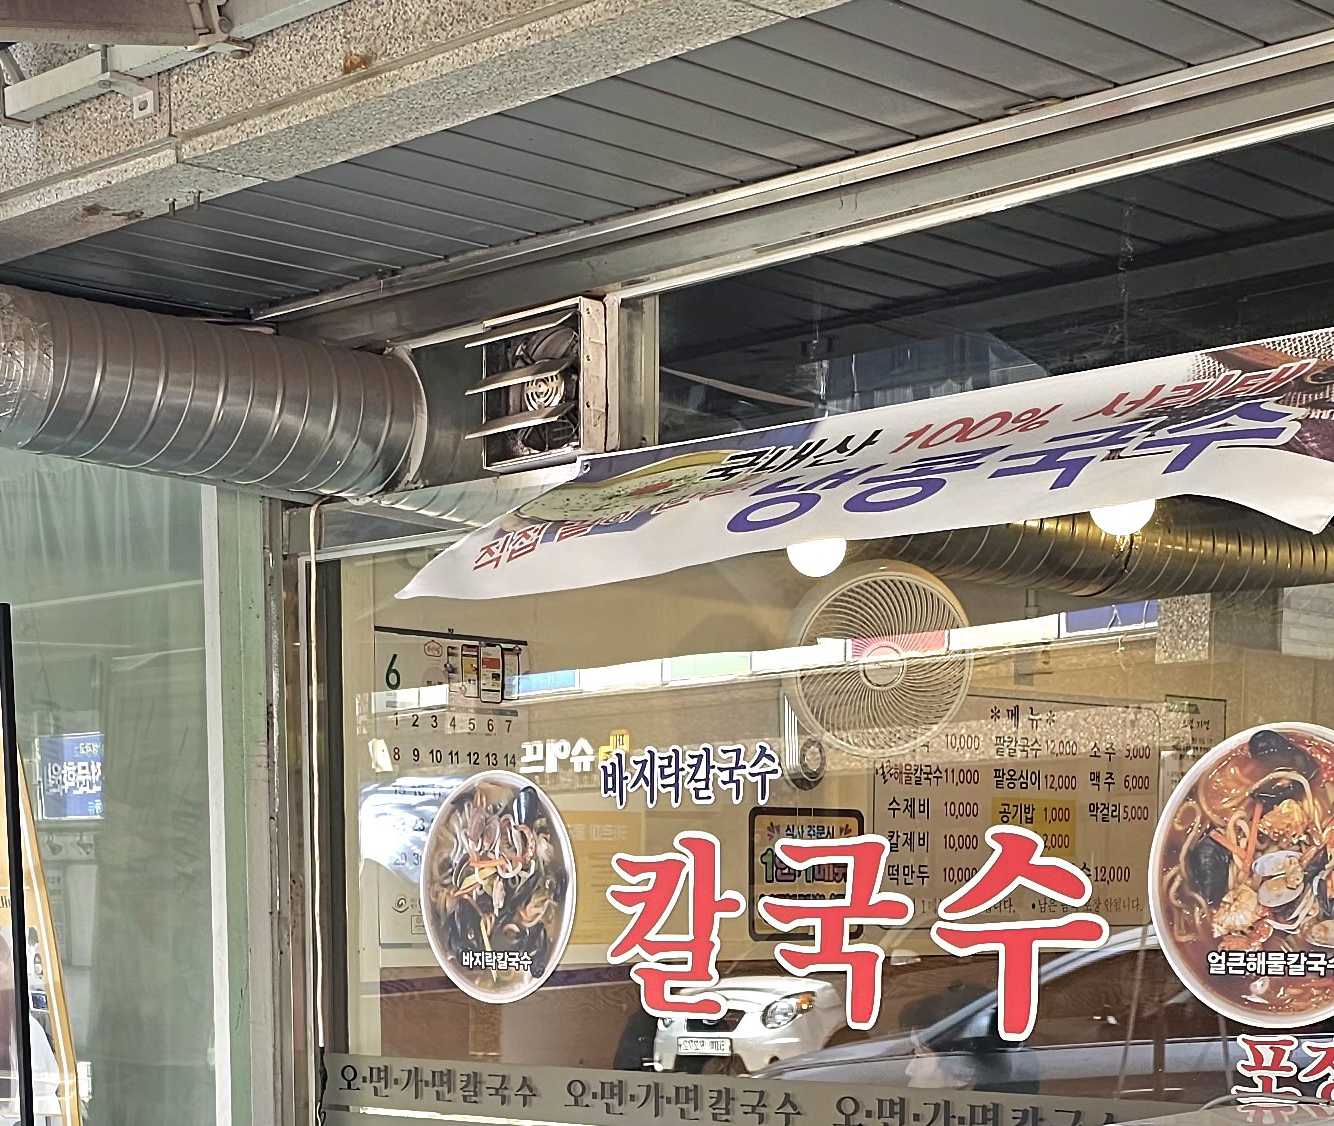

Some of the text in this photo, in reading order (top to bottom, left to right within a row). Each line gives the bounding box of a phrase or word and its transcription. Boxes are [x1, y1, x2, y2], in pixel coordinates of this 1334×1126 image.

[701, 429, 878, 483] 국내산
[904, 402, 1063, 452] 100%
[385, 653, 402, 690] 6
[944, 733, 980, 751] 10,000
[994, 735, 1078, 759] 팥칼국수 12,000
[1089, 742, 1117, 762] 소주
[393, 747, 517, 768] 8 9 10 11 12 13 14
[601, 743, 781, 808] 바지락칼국수
[944, 768, 980, 786] 11,000
[993, 768, 1077, 791] 팥옹심이 12,000
[1089, 771, 1150, 791] 맥주 6,000
[887, 796, 979, 820] 수제비 10,000
[998, 803, 1071, 825] 공기밥 1,000
[1088, 802, 1149, 823] 막걸리 5,000
[887, 830, 978, 853] 칼제비 10,000
[887, 864, 930, 886] 떡만두
[1093, 866, 1131, 884] 12,000
[609, 826, 1108, 1041] 칼국수
[462, 950, 533, 971] 바지락칼국수
